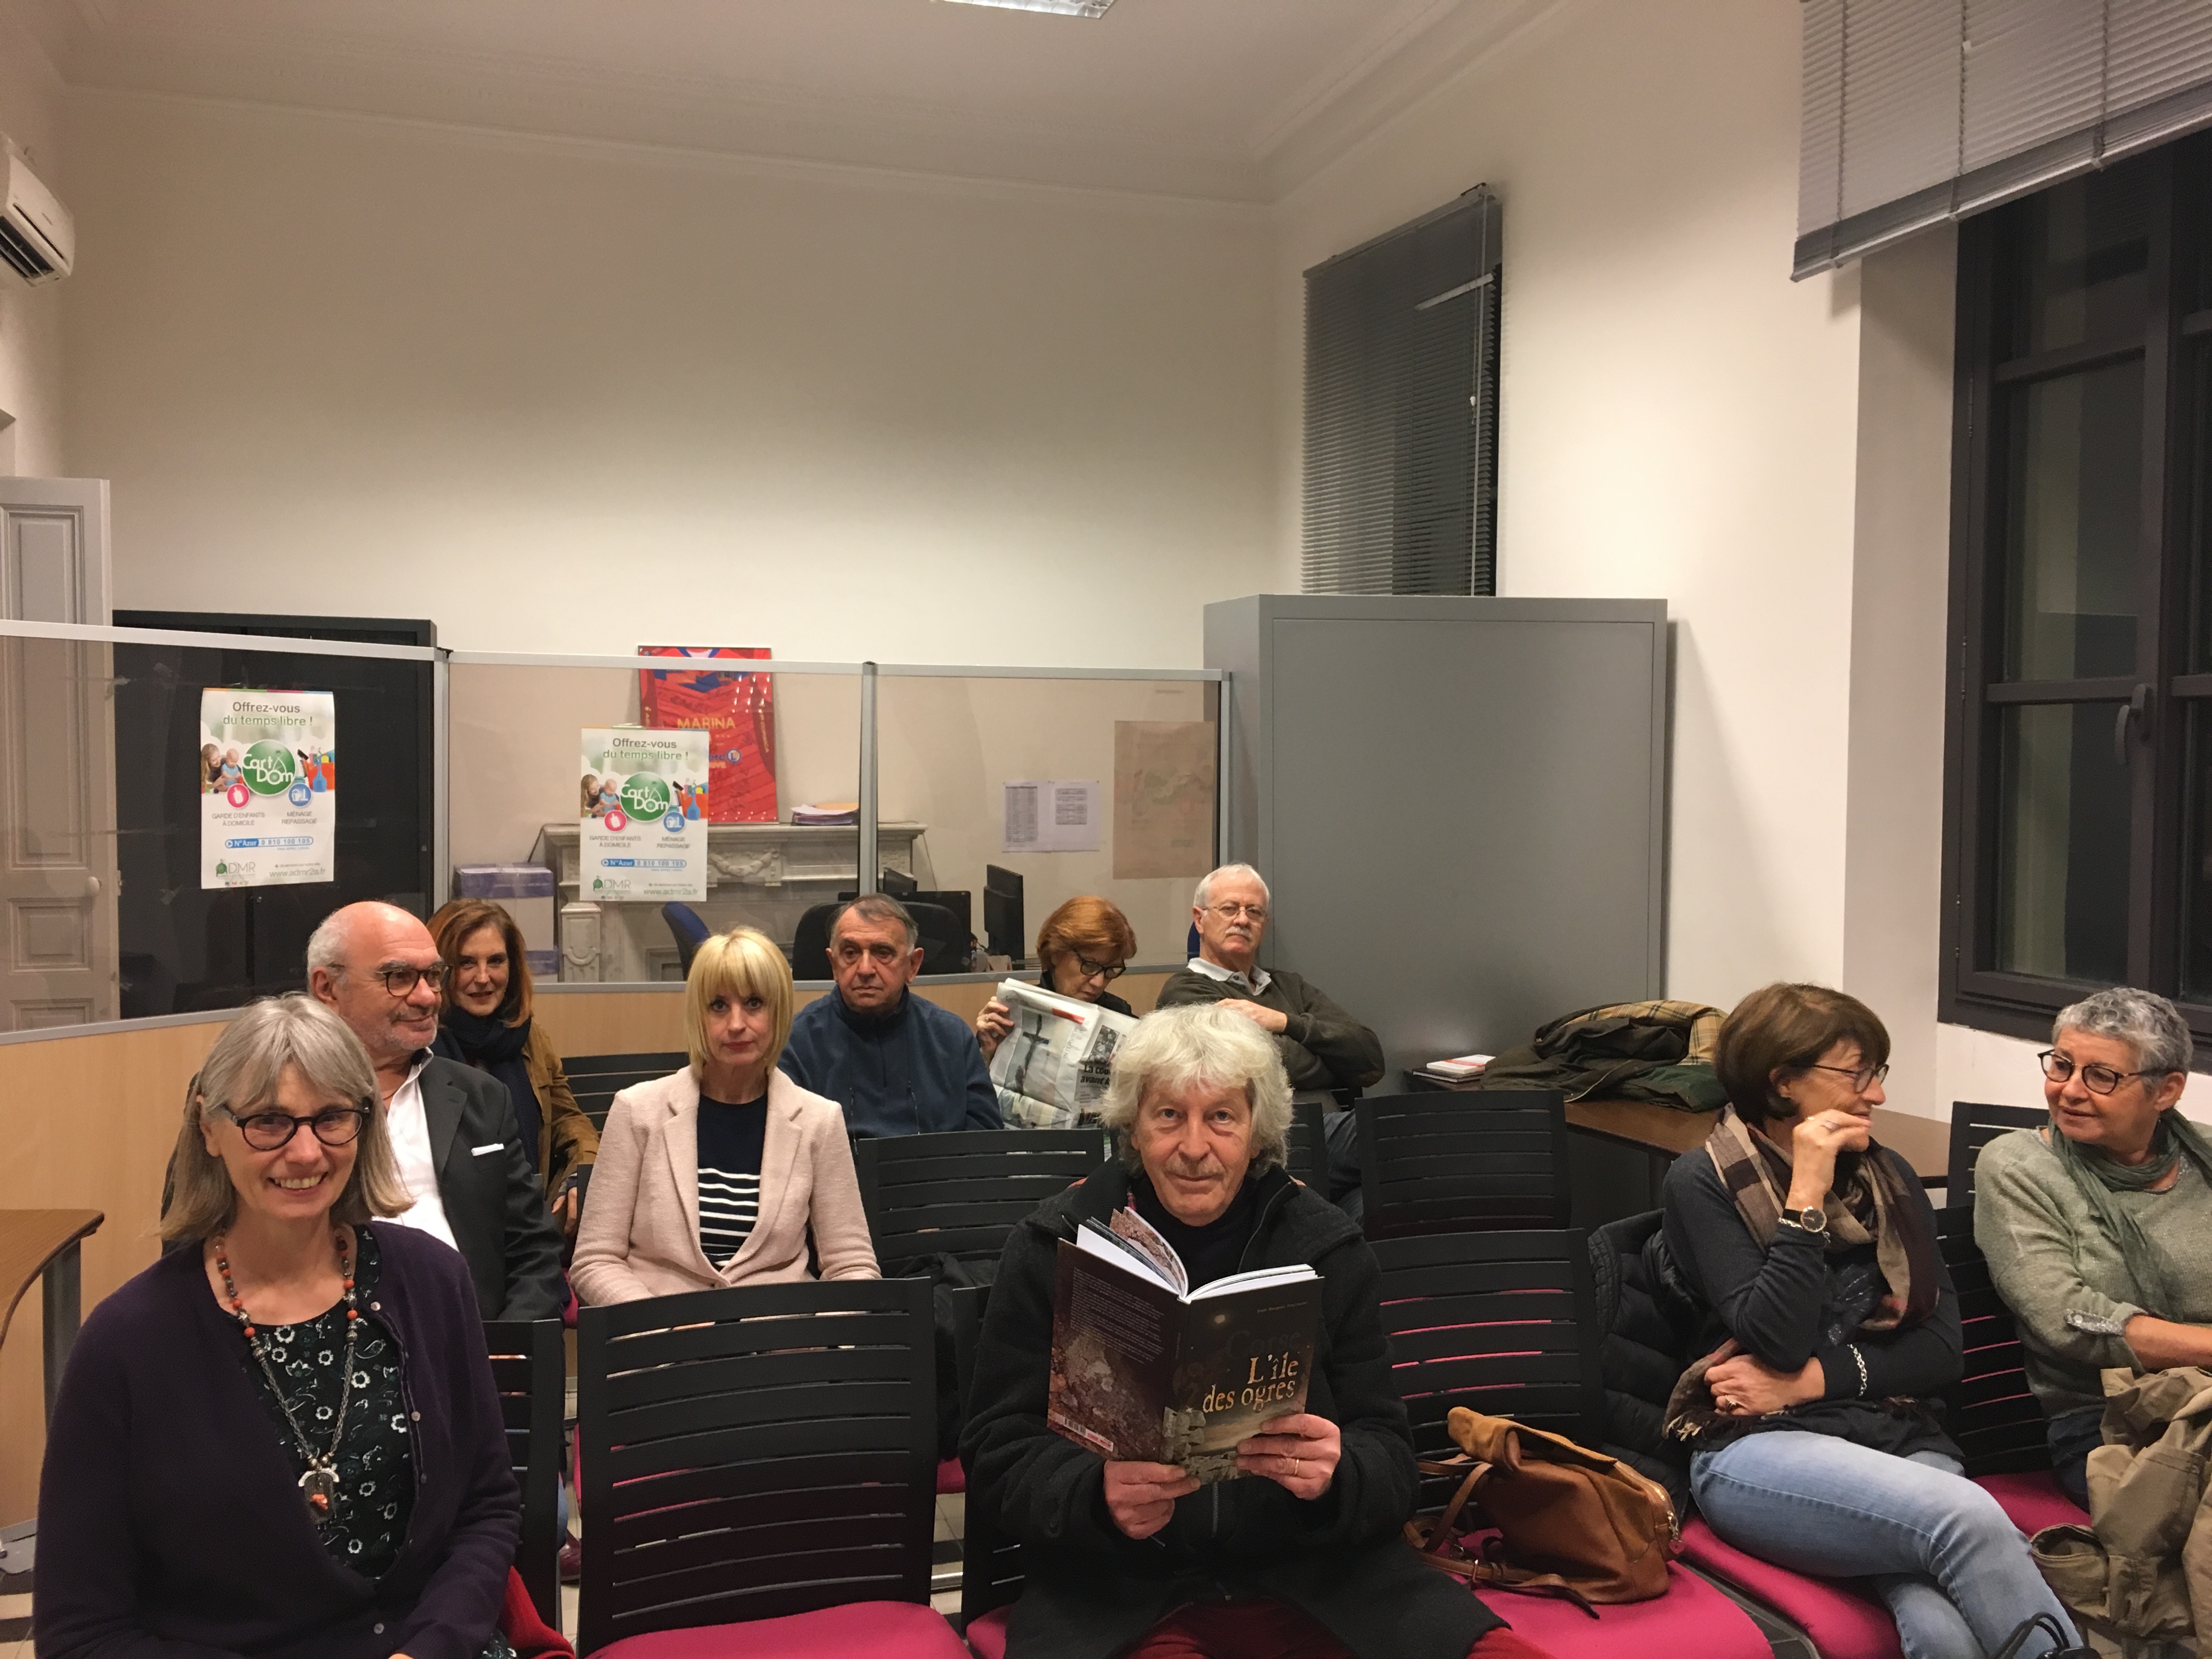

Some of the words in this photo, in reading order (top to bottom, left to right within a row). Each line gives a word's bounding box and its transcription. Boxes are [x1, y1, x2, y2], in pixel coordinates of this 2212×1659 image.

[233, 702, 300, 713] Offrez-vous
[223, 715, 237, 725] du
[240, 715, 276, 727] temps
[280, 715, 306, 726] libre
[677, 717, 736, 729] MARINA
[612, 738, 677, 748] Offrez-vous
[603, 749, 617, 758] du
[620, 750, 654, 761] temps
[658, 751, 682, 760] libre
[1247, 1352, 1299, 1384] L'île
[1203, 1384, 1235, 1413] des
[1241, 1380, 1295, 1414] ogres
